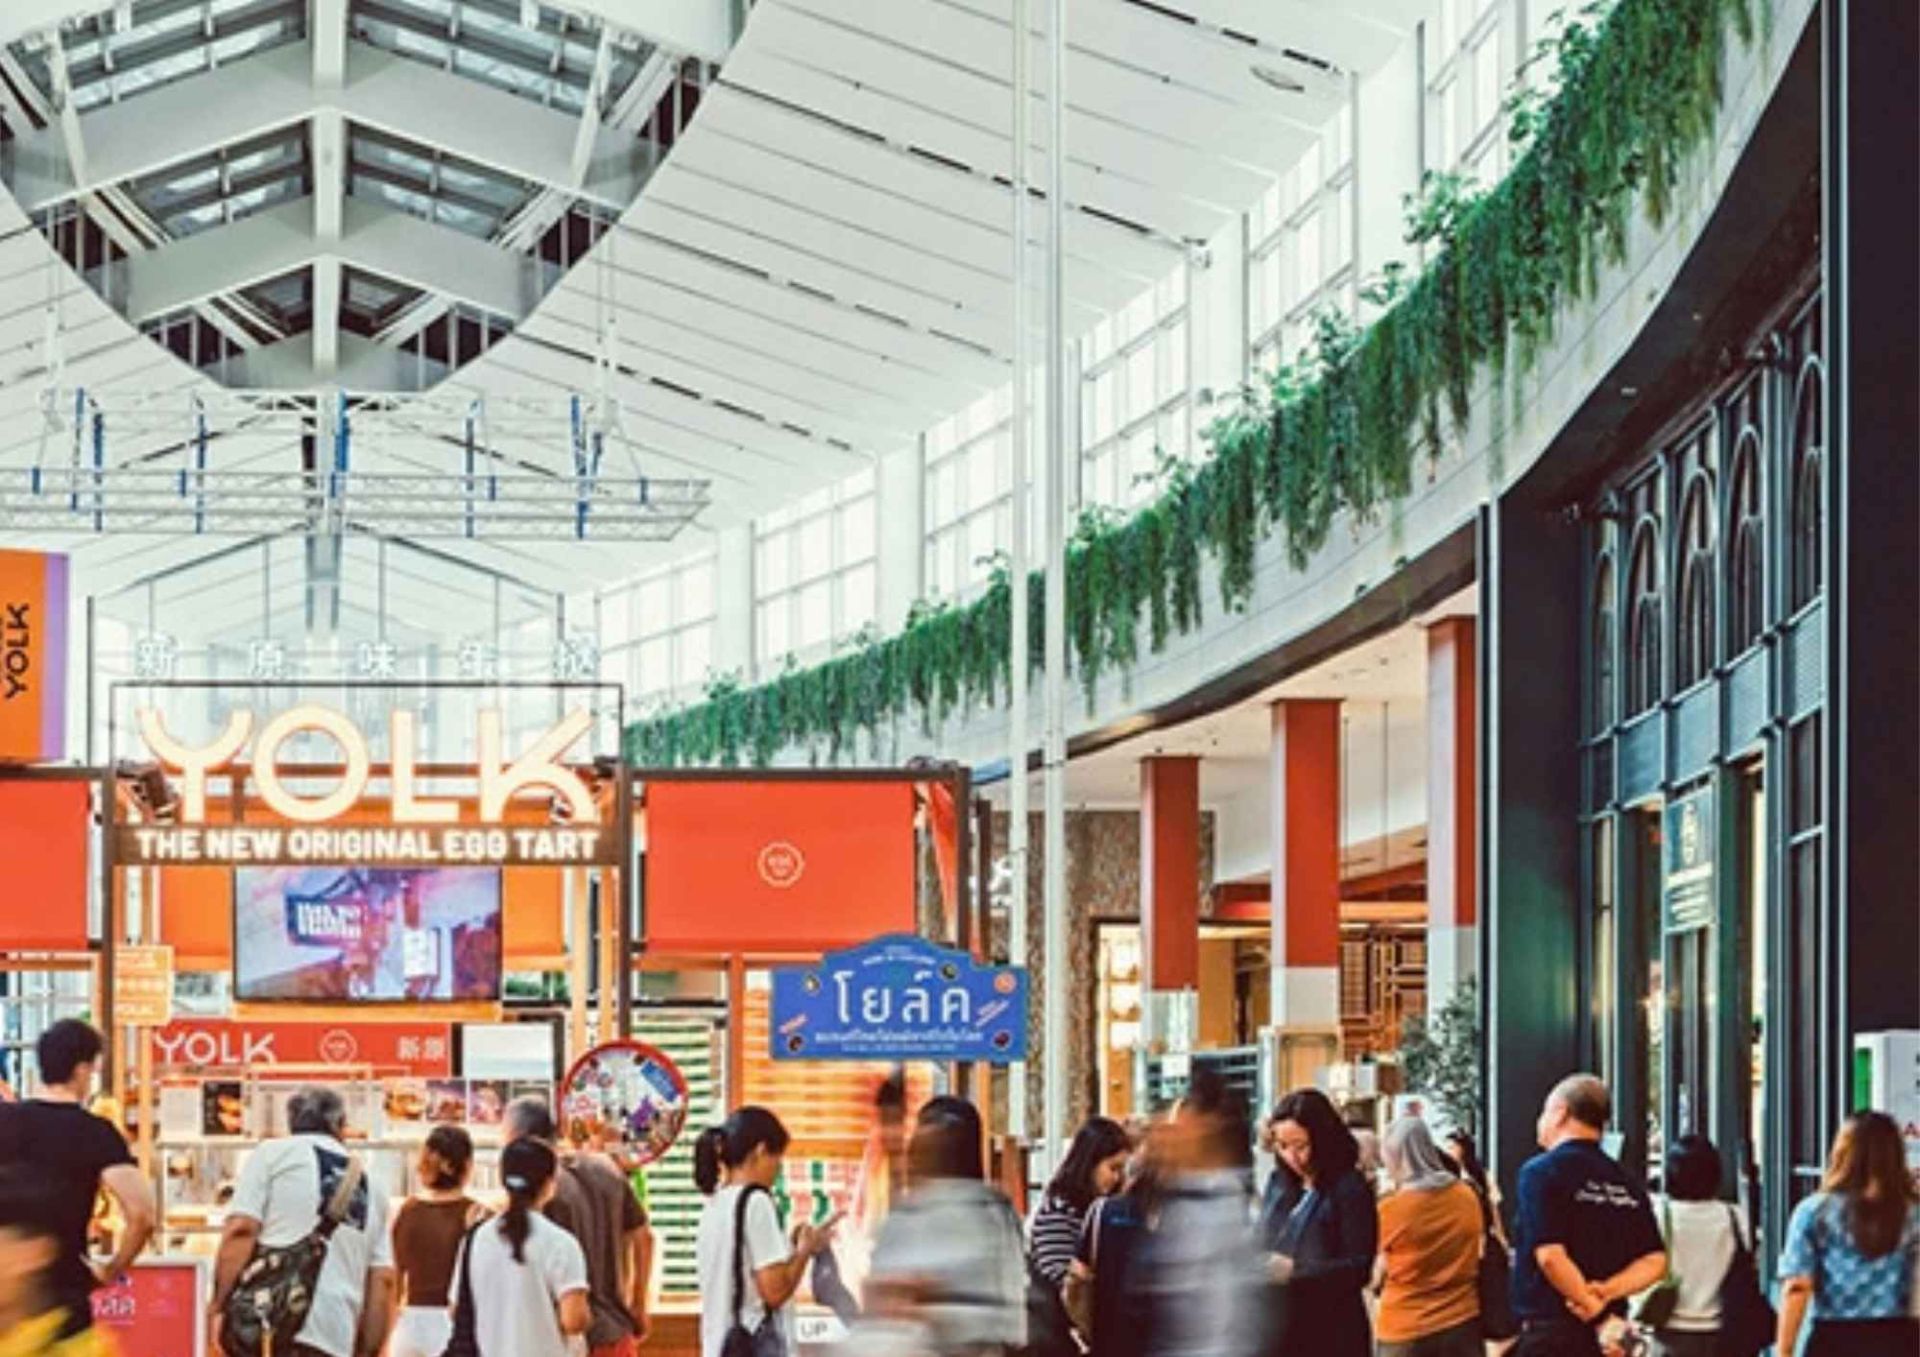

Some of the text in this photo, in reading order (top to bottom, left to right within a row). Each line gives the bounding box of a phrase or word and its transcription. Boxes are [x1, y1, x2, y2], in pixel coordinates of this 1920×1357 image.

[5, 603, 30, 699] YOLK
[134, 703, 600, 823] YOLK
[136, 829, 599, 859] THE NEW ORIGINAL EGG TART
[833, 970, 970, 1024] โยล์ค
[154, 1031, 277, 1066] YOLK
